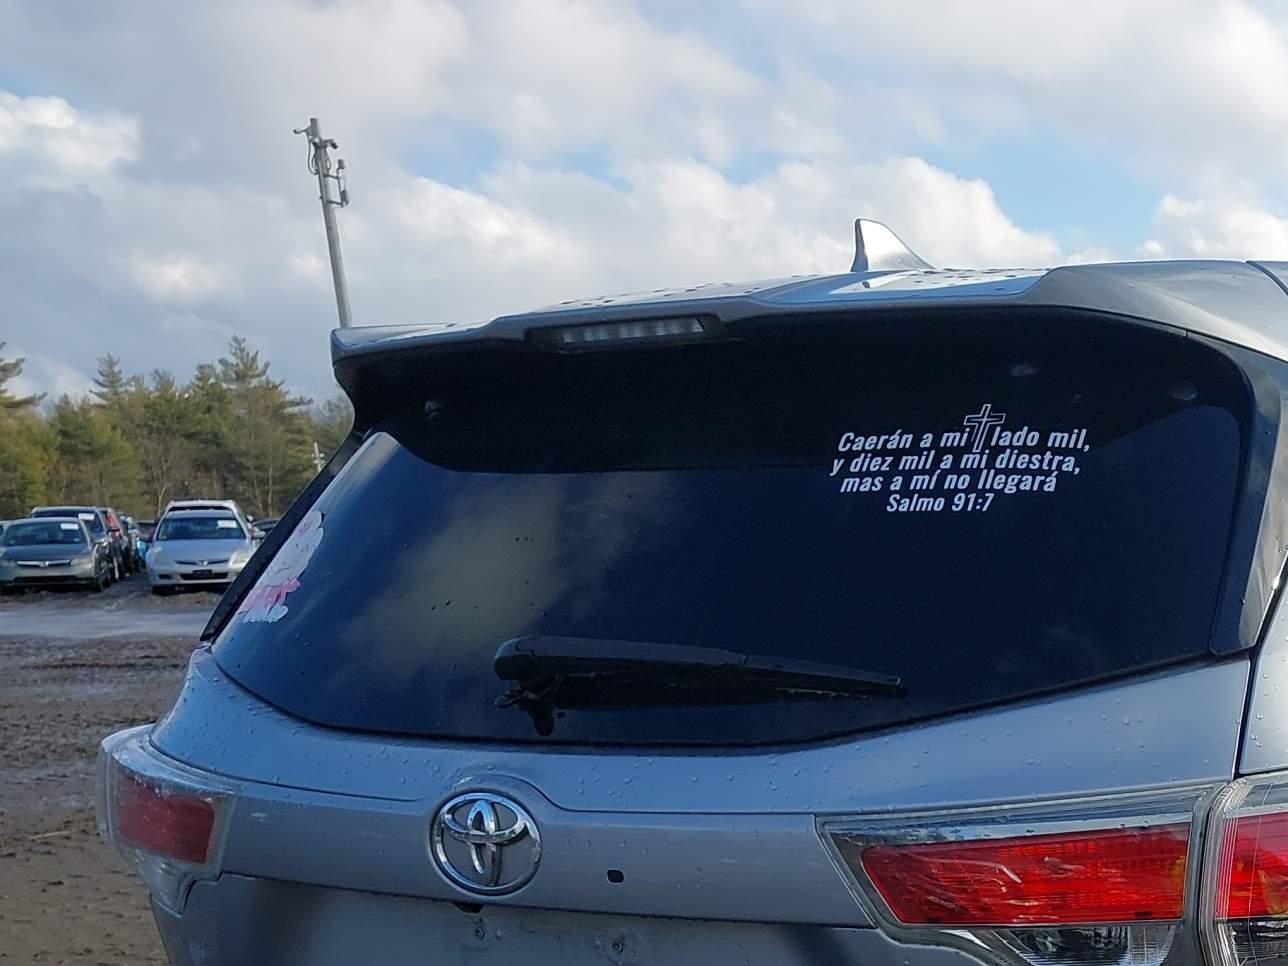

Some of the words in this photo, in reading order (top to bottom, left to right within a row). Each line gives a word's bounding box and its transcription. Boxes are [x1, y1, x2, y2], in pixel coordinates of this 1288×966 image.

[838, 429, 913, 452] Caerán
[919, 432, 934, 448] a
[940, 428, 970, 448] mi
[991, 426, 1040, 448] lado
[1048, 428, 1091, 453] mil,
[829, 457, 845, 477] y
[850, 453, 892, 472] diez
[898, 450, 936, 471] mil
[939, 454, 954, 469] a
[960, 450, 988, 469] mi
[995, 449, 1081, 475] diestra,
[840, 475, 884, 493] mas
[889, 475, 903, 491] a
[909, 470, 942, 491] mí
[943, 474, 971, 490] no
[977, 469, 1059, 494] llegará
[886, 493, 946, 512] Salmo
[951, 492, 995, 512] 91:7
